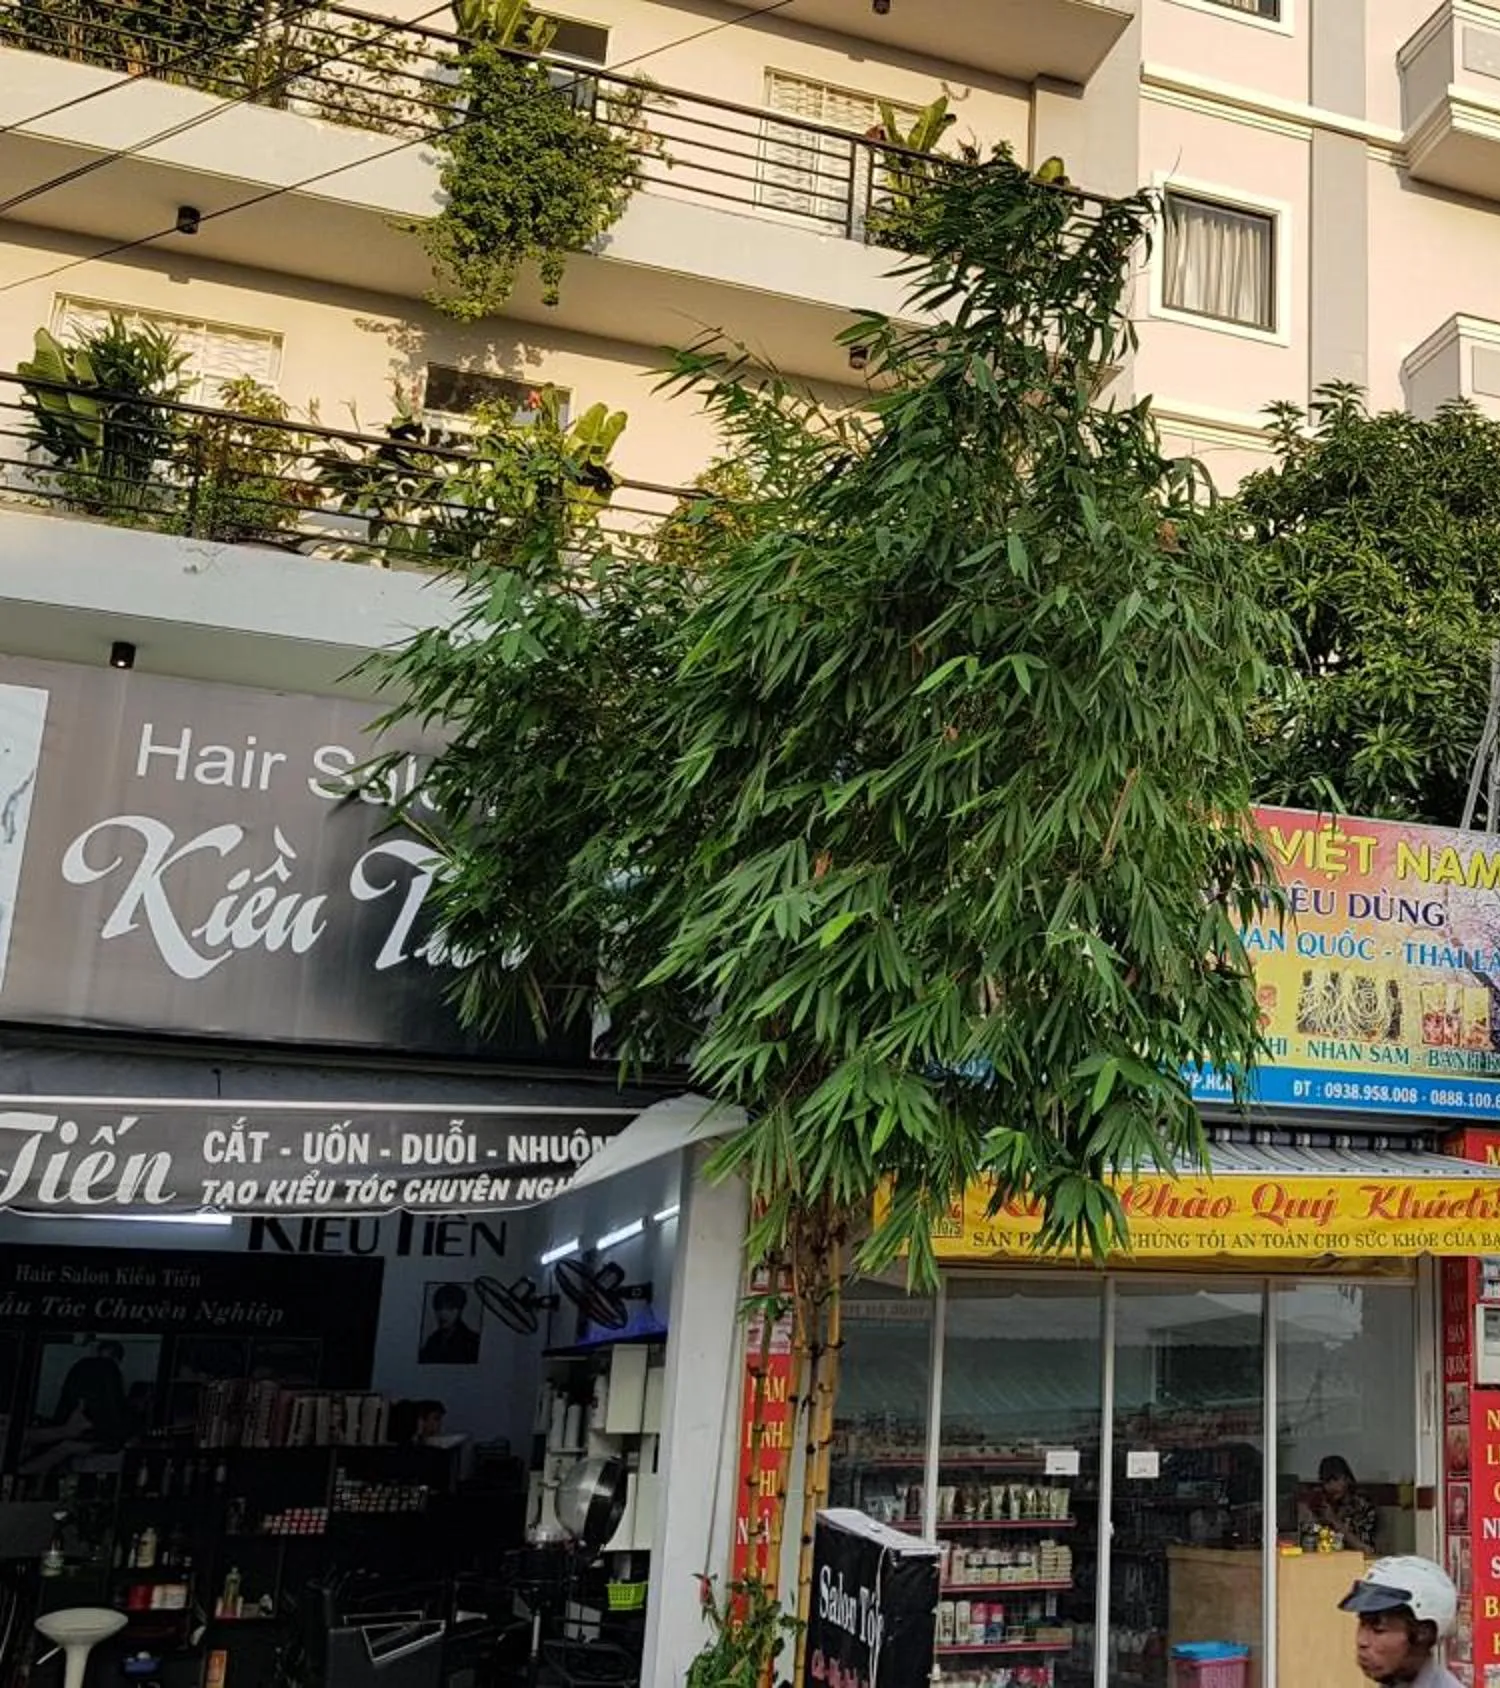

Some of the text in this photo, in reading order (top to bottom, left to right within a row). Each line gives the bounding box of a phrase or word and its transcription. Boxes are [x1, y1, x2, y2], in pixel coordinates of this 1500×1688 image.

[136, 722, 287, 790] Hair
[1270, 823, 1378, 882] VIỆT
[61, 815, 328, 980] Kiều
[1348, 887, 1445, 927] DÙNG
[0, 1111, 177, 1205] Tiến
[203, 1117, 269, 1164] CẮT
[302, 1119, 370, 1164] UỐN
[401, 1119, 477, 1164] DUỖI
[200, 1169, 576, 1212] TẠO KIỂU TÓC CHUYÊN NGH
[1231, 1232, 1257, 1249] AN
[1313, 1232, 1350, 1249] CHO
[819, 1564, 858, 1636] Salon
